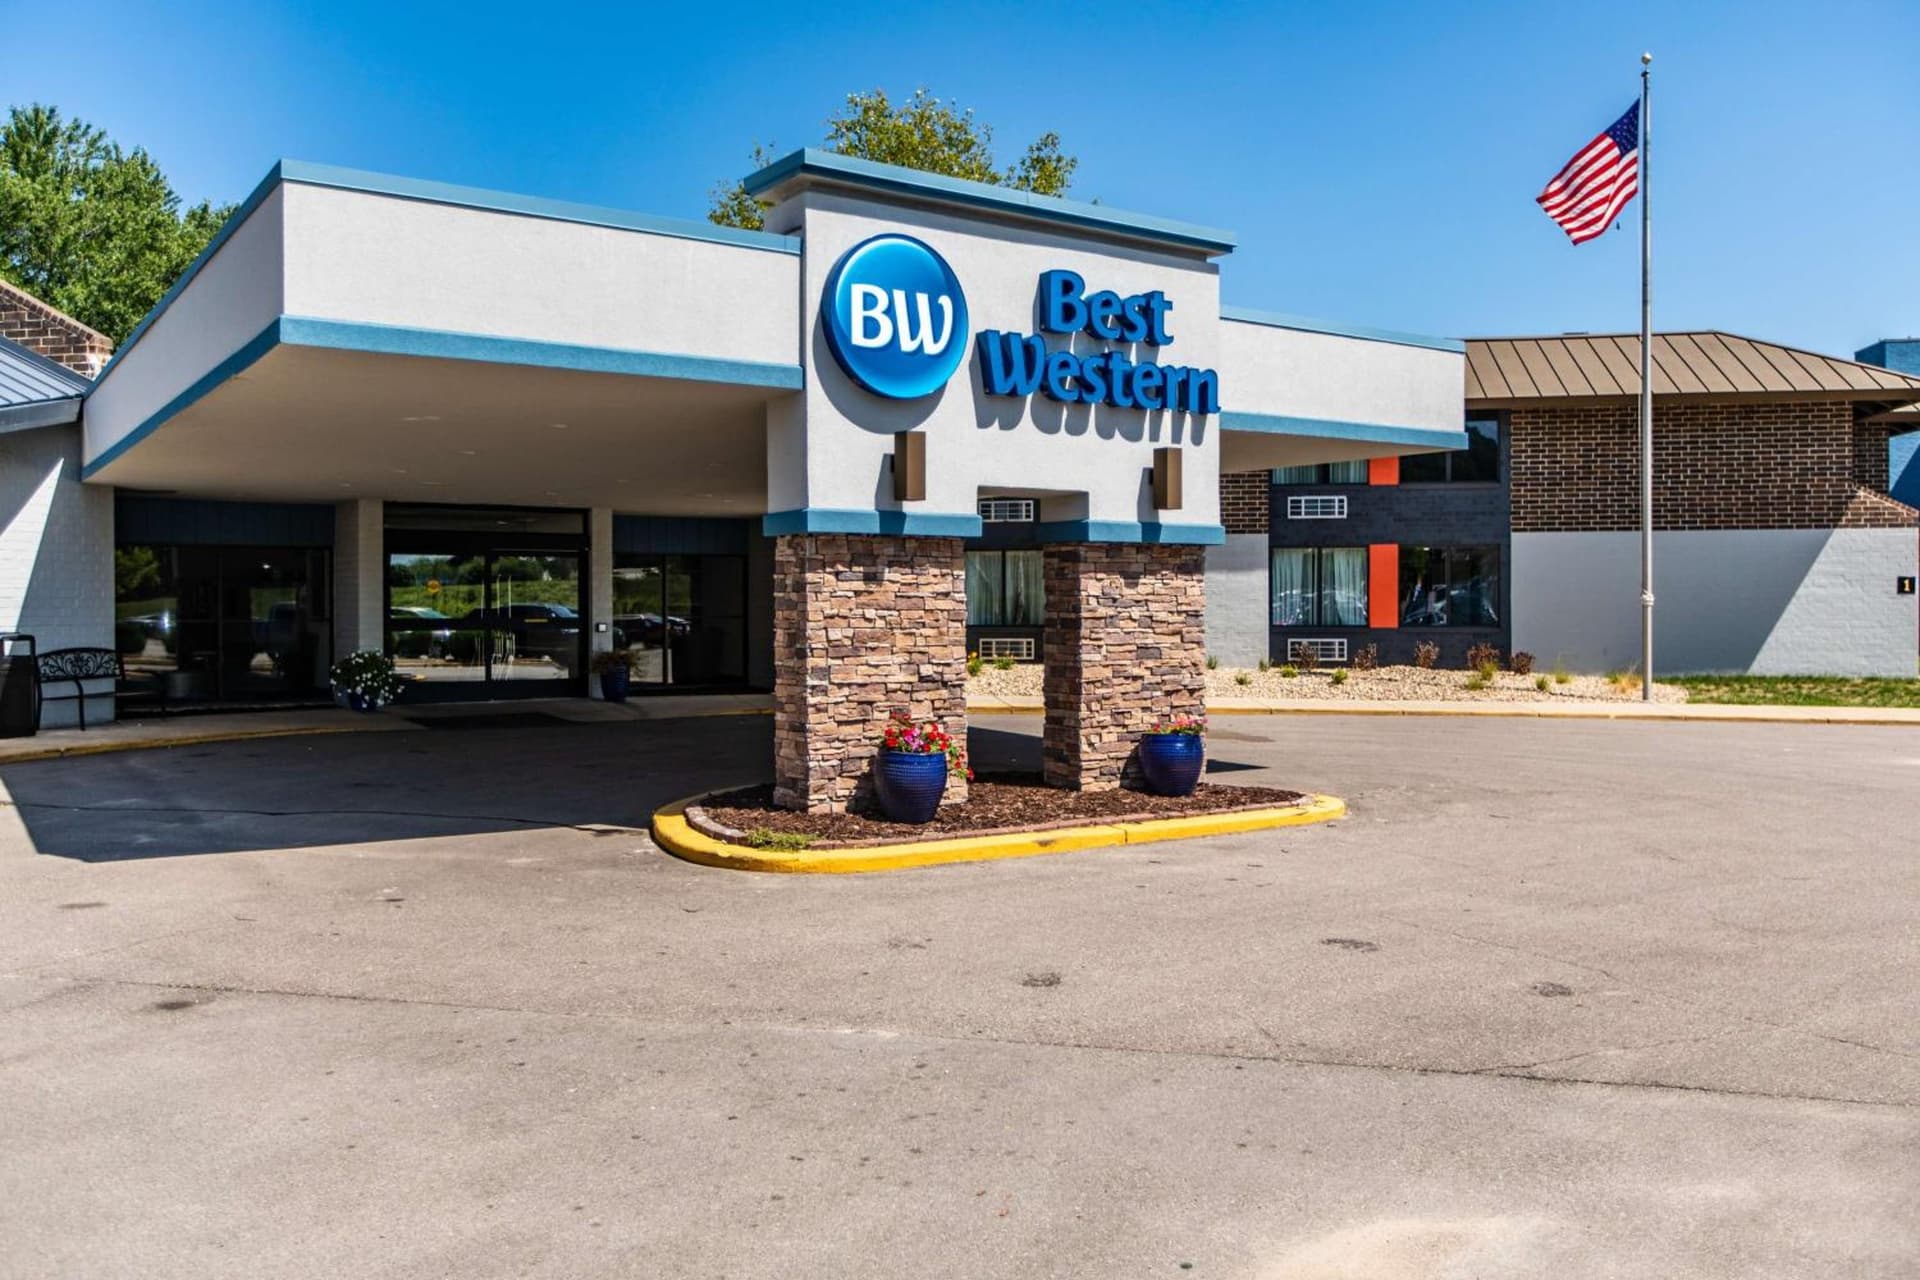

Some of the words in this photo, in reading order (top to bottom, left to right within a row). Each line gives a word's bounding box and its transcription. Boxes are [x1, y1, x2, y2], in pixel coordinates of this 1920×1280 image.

[850, 283, 953, 356] BW
[1039, 269, 1173, 346] Best
[975, 329, 1221, 414] Western
